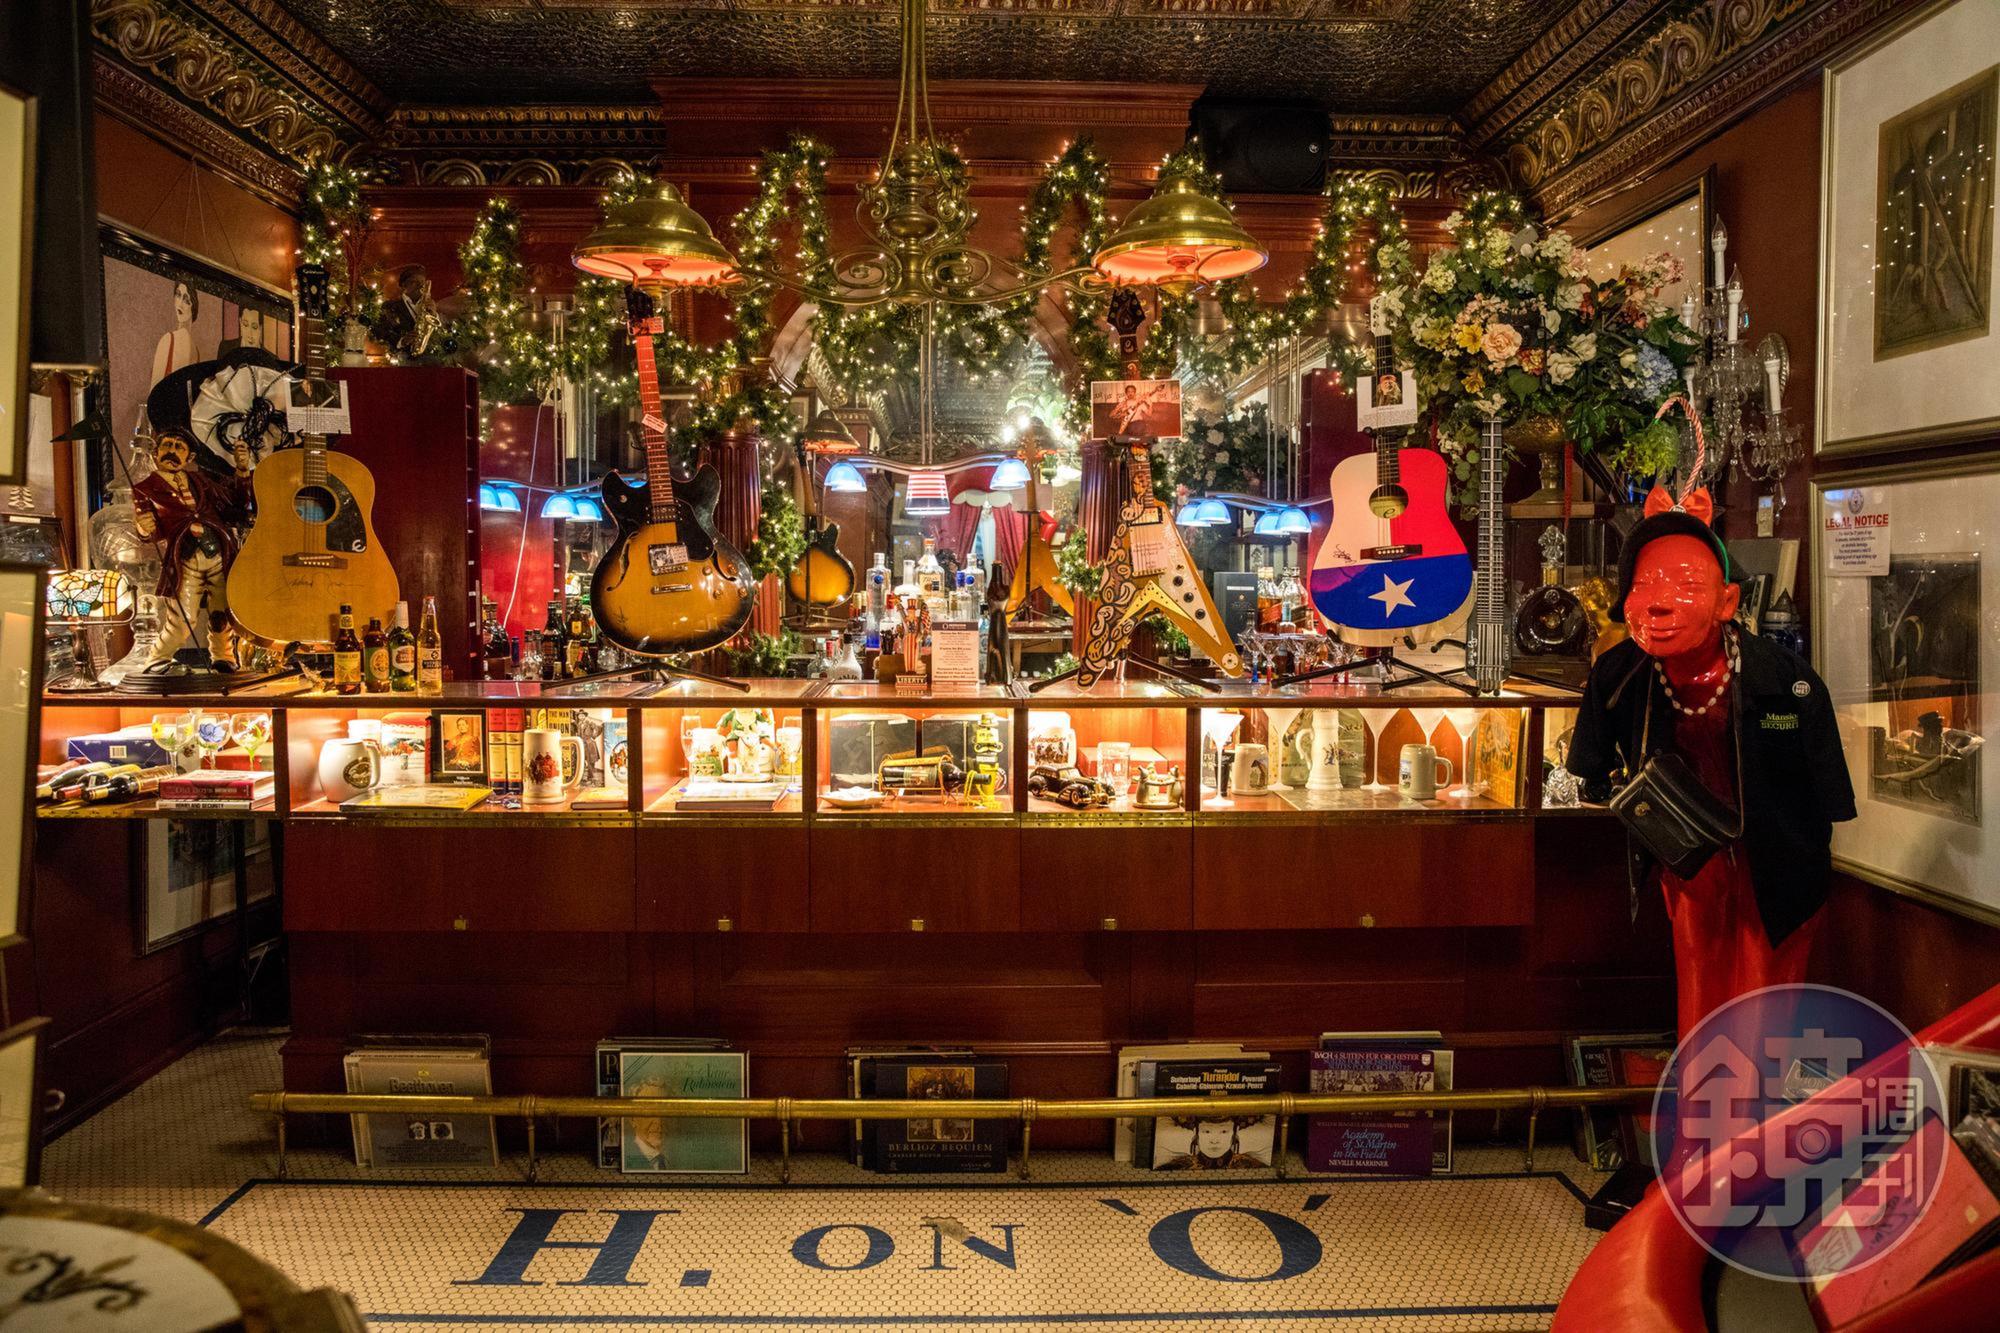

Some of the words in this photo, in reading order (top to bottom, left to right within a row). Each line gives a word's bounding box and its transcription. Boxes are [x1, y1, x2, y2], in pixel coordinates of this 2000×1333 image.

[1825, 516, 1852, 529] LEGAL
[1854, 513, 1889, 526] NOTICE
[1202, 1071, 1240, 1083] Turandot
[389, 1076, 456, 1094] Beethoven
[682, 1077, 737, 1093] Rubinstein
[1342, 1128, 1385, 1141] Academy
[888, 1143, 937, 1152] BERLIOZ
[941, 1143, 993, 1152] REQUIEM
[1343, 1140, 1352, 1149] of
[1333, 1150, 1344, 1158] in
[1345, 1149, 1360, 1159] the
[1361, 1149, 1388, 1159] Fields
[1328, 1159, 1355, 1167] NEVILLE
[1355, 1159, 1389, 1167] MARRINER
[451, 1207, 712, 1288] H.
[791, 1217, 1025, 1272] ON
